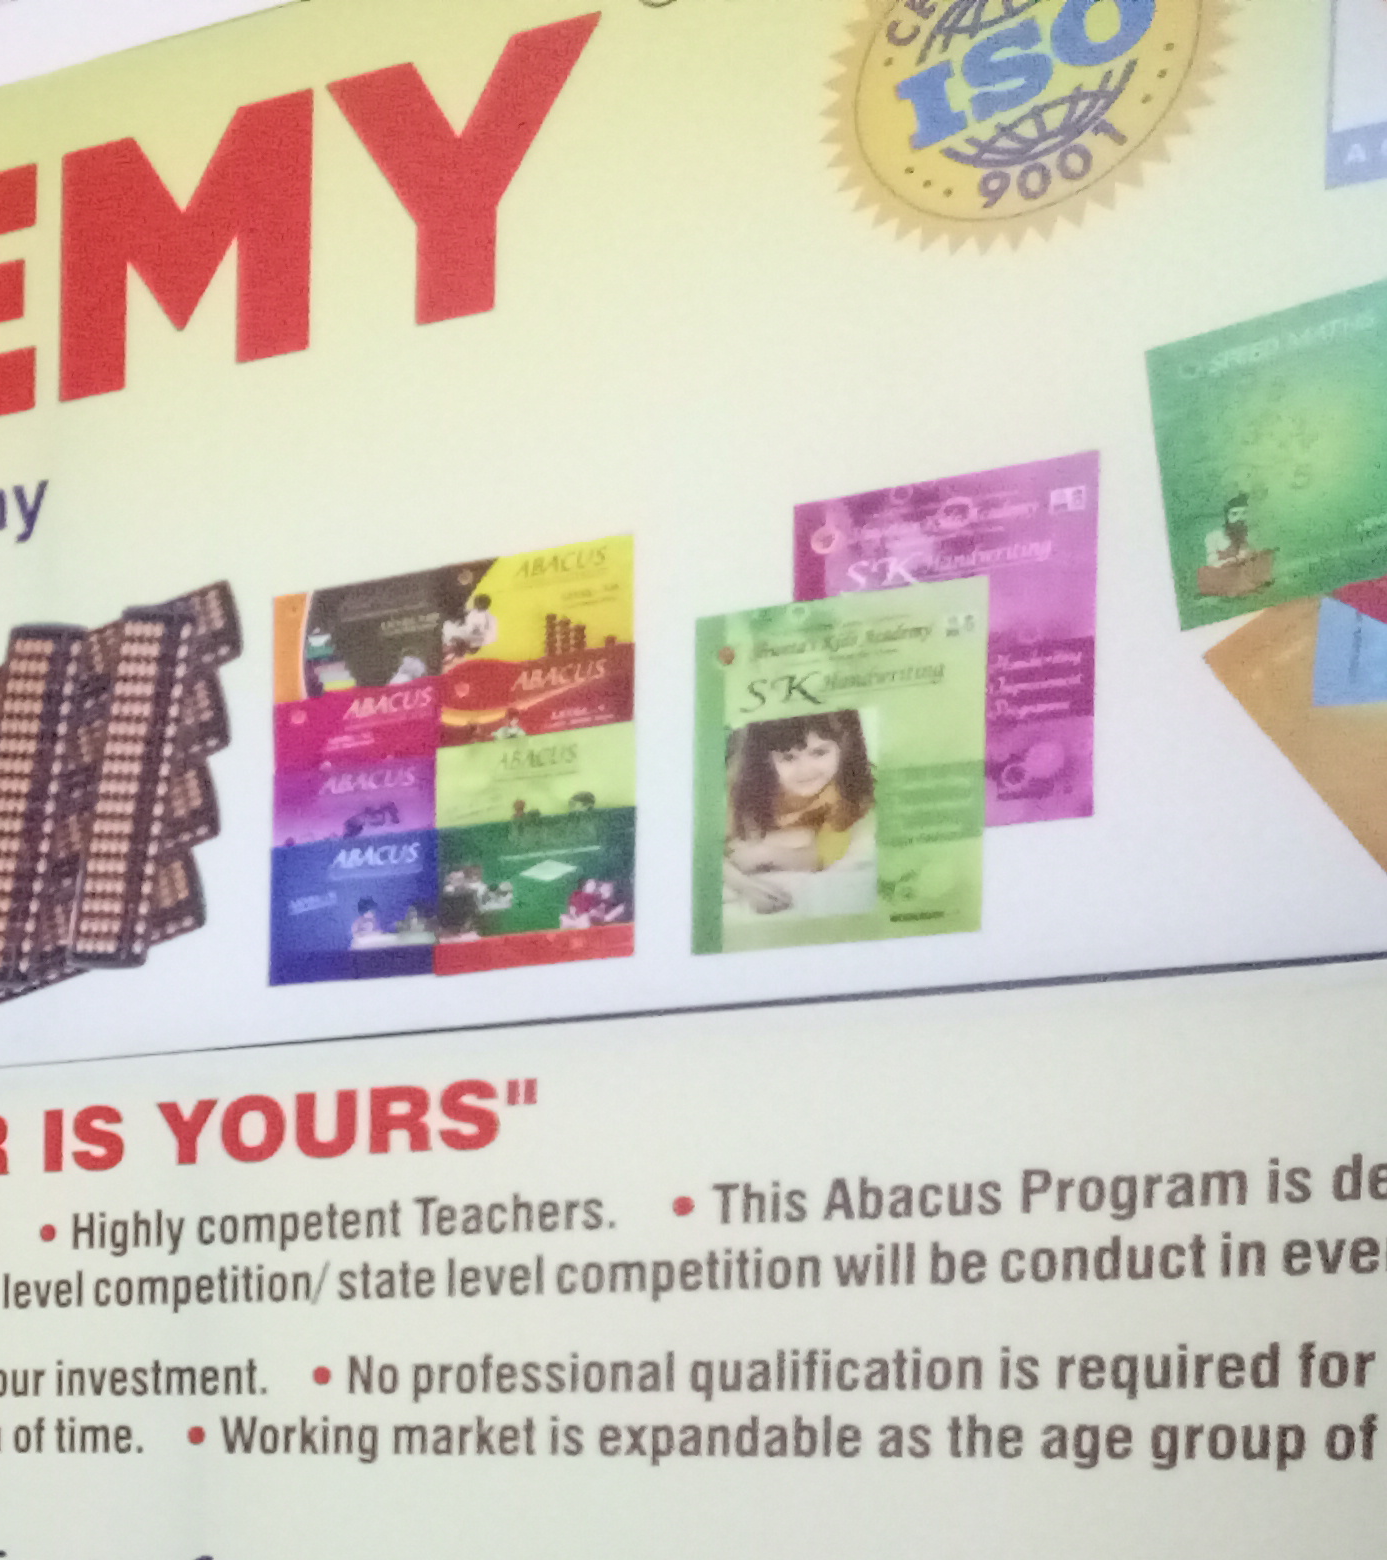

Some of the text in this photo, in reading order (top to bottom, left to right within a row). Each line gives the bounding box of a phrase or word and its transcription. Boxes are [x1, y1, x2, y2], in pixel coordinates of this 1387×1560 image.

[899, 0, 1154, 167] ISO
[343, 687, 430, 717] ABACUS
[511, 659, 603, 689] ABACUS
[334, 844, 418, 868] ABACUS
[44, 1106, 124, 1172] IS
[157, 1079, 536, 1165] YOURS"
[4, 1271, 83, 1309] level
[94, 1265, 329, 1313] competition/
[339, 1262, 434, 1300] state
[448, 1255, 543, 1297] level
[557, 1247, 820, 1302] competition
[835, 1242, 915, 1287] will
[931, 1242, 987, 1284] be
[1001, 1235, 1206, 1283] conduct
[1221, 1232, 1265, 1277] in
[349, 1342, 1375, 1403] No professional qualification is required for
[221, 1414, 1378, 1470] Working market is expandable as the age group of
